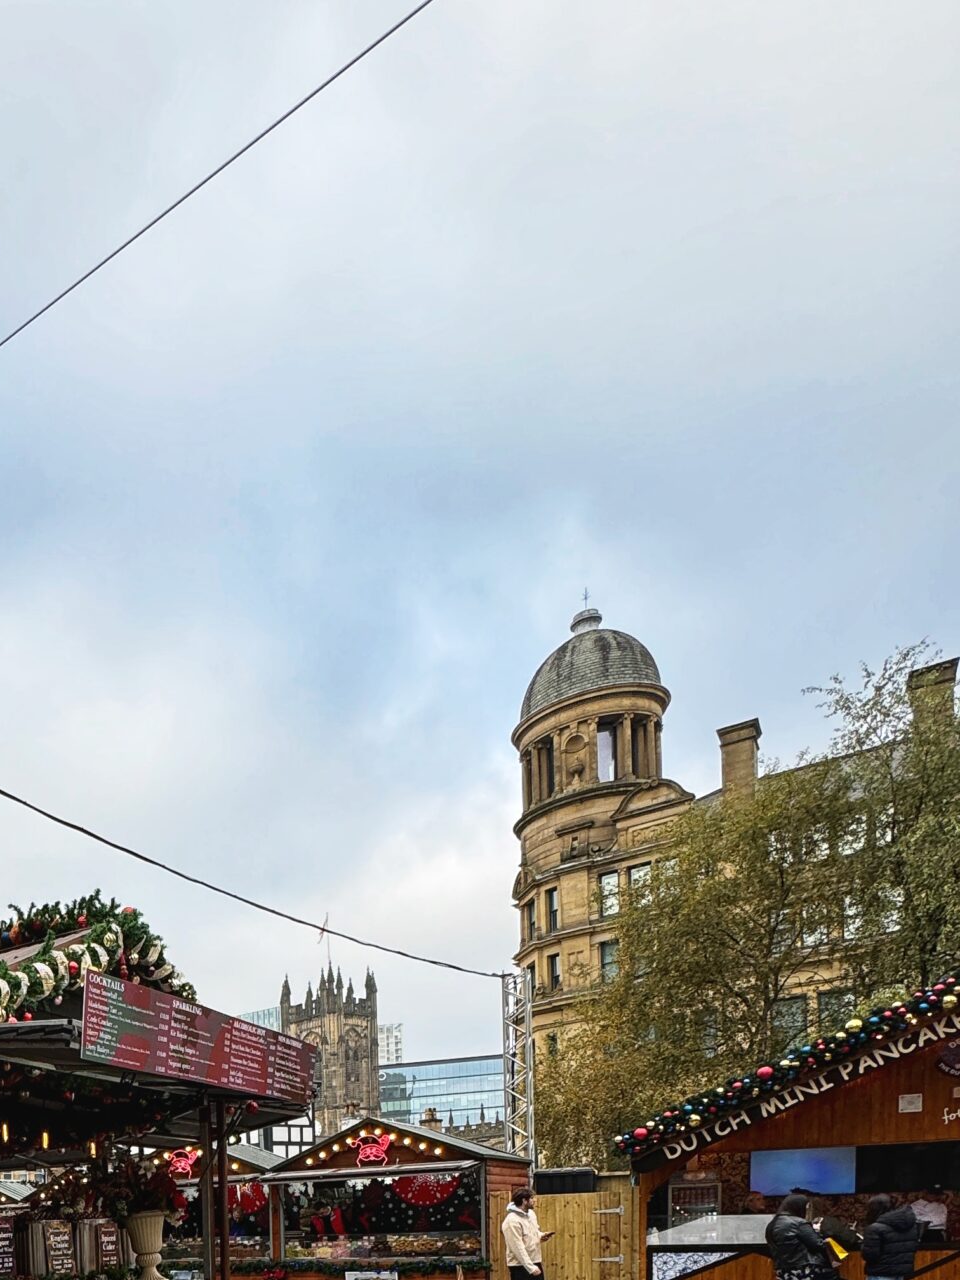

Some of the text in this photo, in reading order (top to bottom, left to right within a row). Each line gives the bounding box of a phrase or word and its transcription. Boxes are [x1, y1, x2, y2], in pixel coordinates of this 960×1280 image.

[89, 973, 125, 992] COCKTAILS
[172, 1000, 203, 1016] SPARKLING
[662, 1110, 752, 1160] DUTCH
[760, 1073, 835, 1118] MINI
